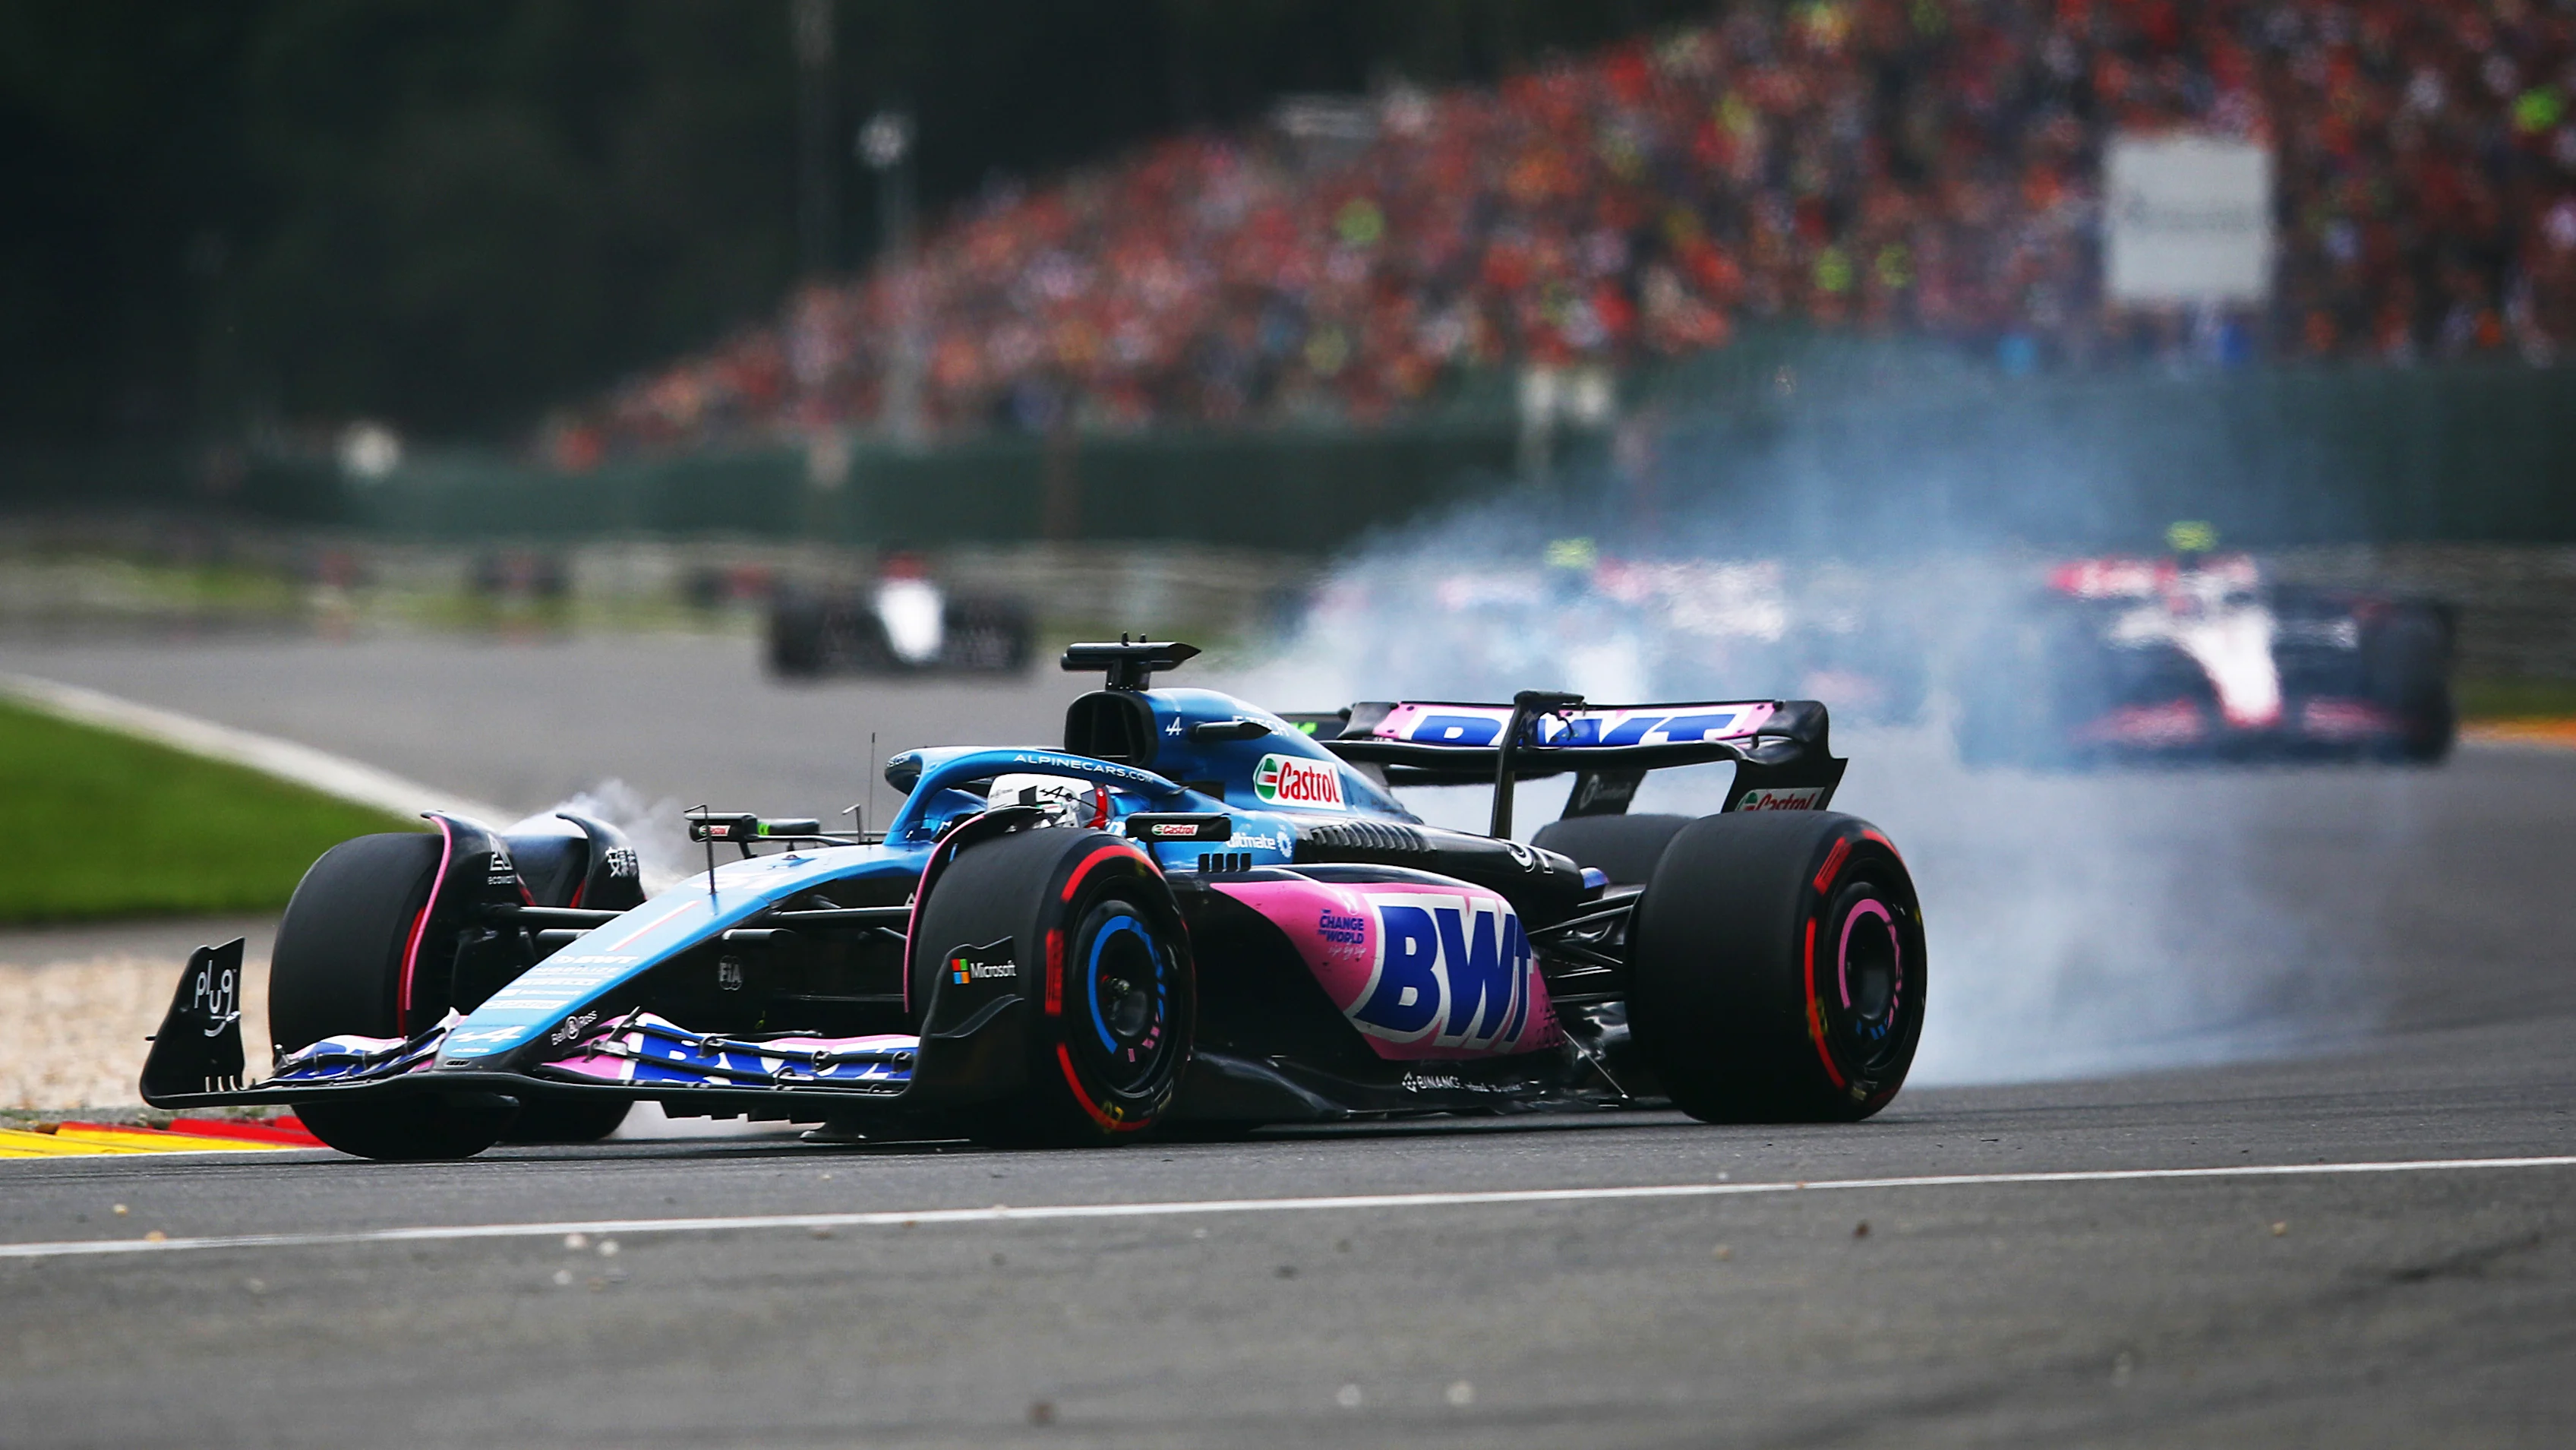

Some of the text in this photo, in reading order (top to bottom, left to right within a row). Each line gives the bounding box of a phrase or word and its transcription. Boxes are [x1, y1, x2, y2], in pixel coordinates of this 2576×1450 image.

[1013, 753, 1154, 783] ALPINECARS.COM
[1278, 762, 1340, 803] Castrol
[1163, 826, 1195, 834] Castrol
[1320, 915, 1364, 931] CHANGE
[1326, 929, 1364, 944] WORLD
[970, 959, 1017, 978] Microsoft
[1352, 905, 1533, 1043] BWT
[194, 959, 233, 1038] plug
